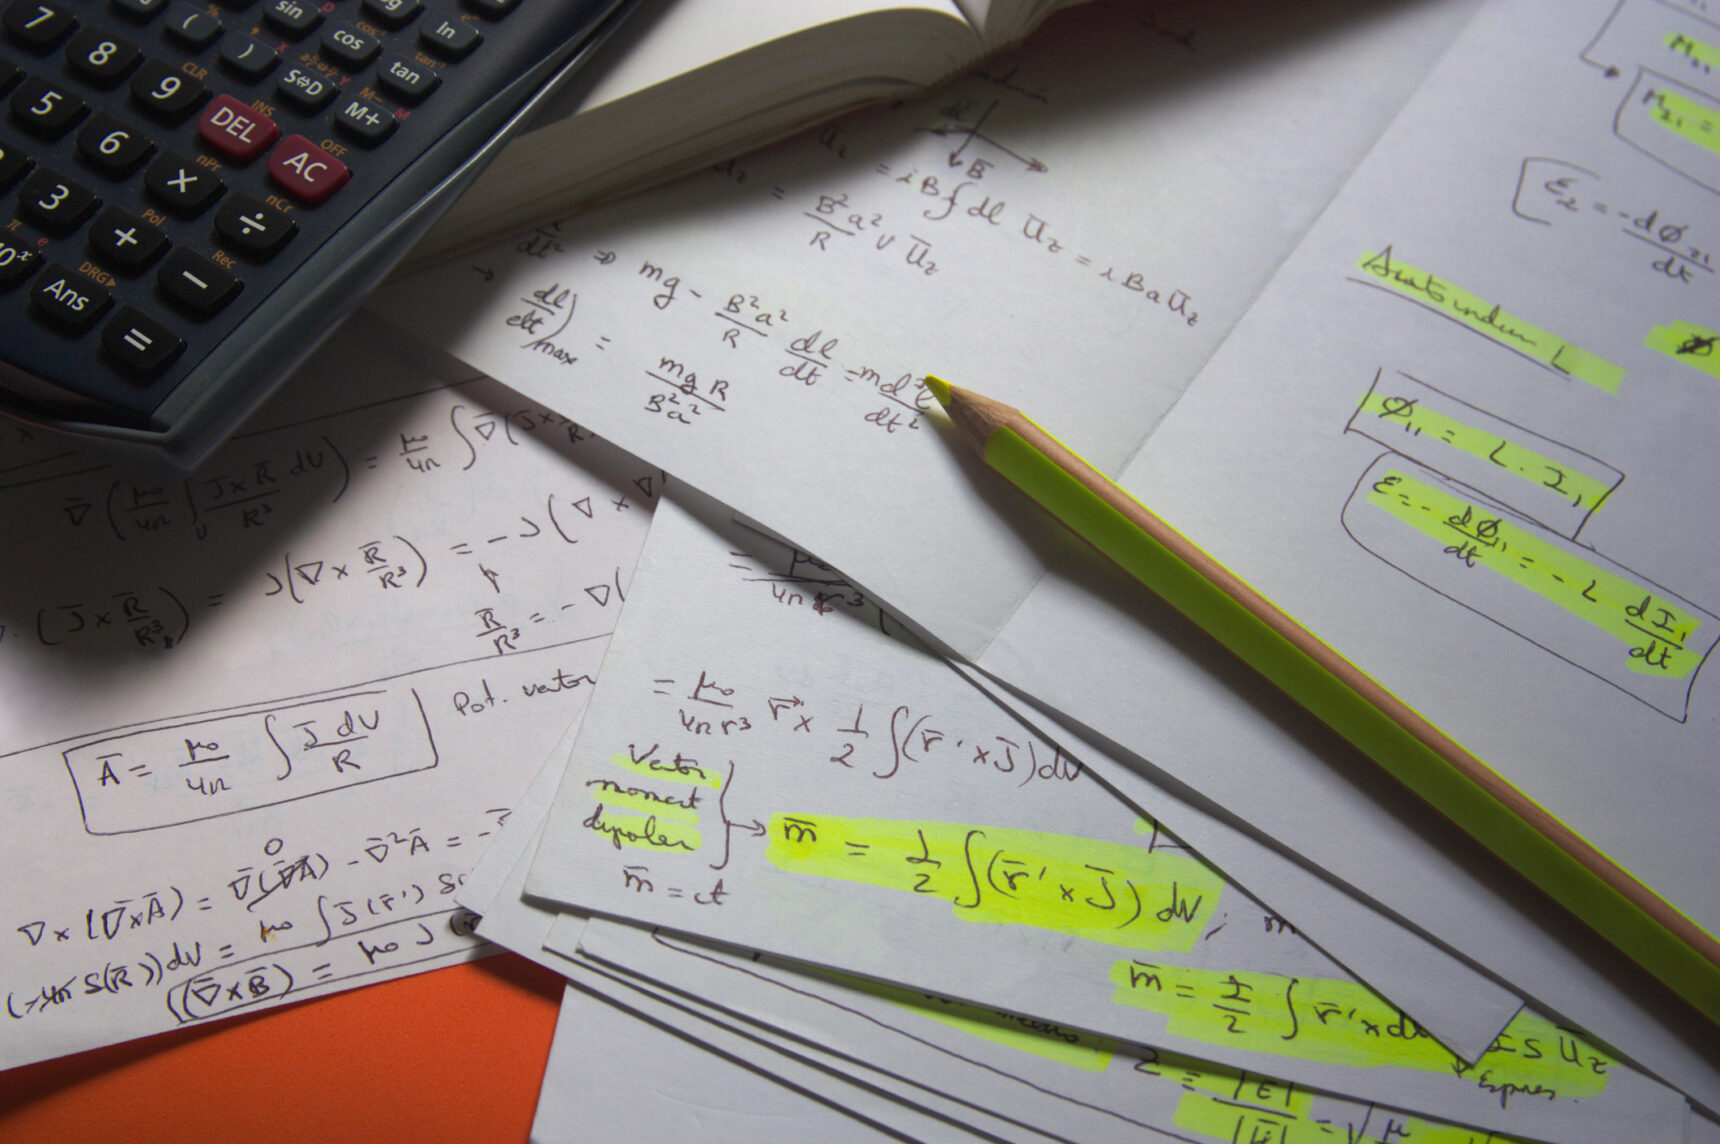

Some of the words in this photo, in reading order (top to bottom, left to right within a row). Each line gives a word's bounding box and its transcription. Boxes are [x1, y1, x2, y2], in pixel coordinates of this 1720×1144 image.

[24, 5, 55, 29] 7
[275, 0, 304, 20] sin
[321, 2, 335, 13] D
[332, 30, 365, 50] cos
[435, 21, 456, 40] ln
[88, 41, 117, 66] 8
[182, 61, 209, 81] CLR
[389, 61, 421, 85] tan
[151, 76, 182, 99] 9
[29, 90, 63, 115] 5
[250, 99, 277, 118] INS
[209, 106, 260, 144] DEL
[344, 101, 381, 127] M+
[394, 108, 412, 121] M
[98, 130, 130, 155] 6
[320, 138, 349, 158] OFF
[196, 154, 222, 172] nPr
[282, 152, 328, 183] AC
[37, 184, 70, 211] 3
[265, 194, 295, 214] nCr
[141, 208, 168, 227] Pol
[211, 249, 237, 271] Rec
[42, 278, 91, 312] Ans
